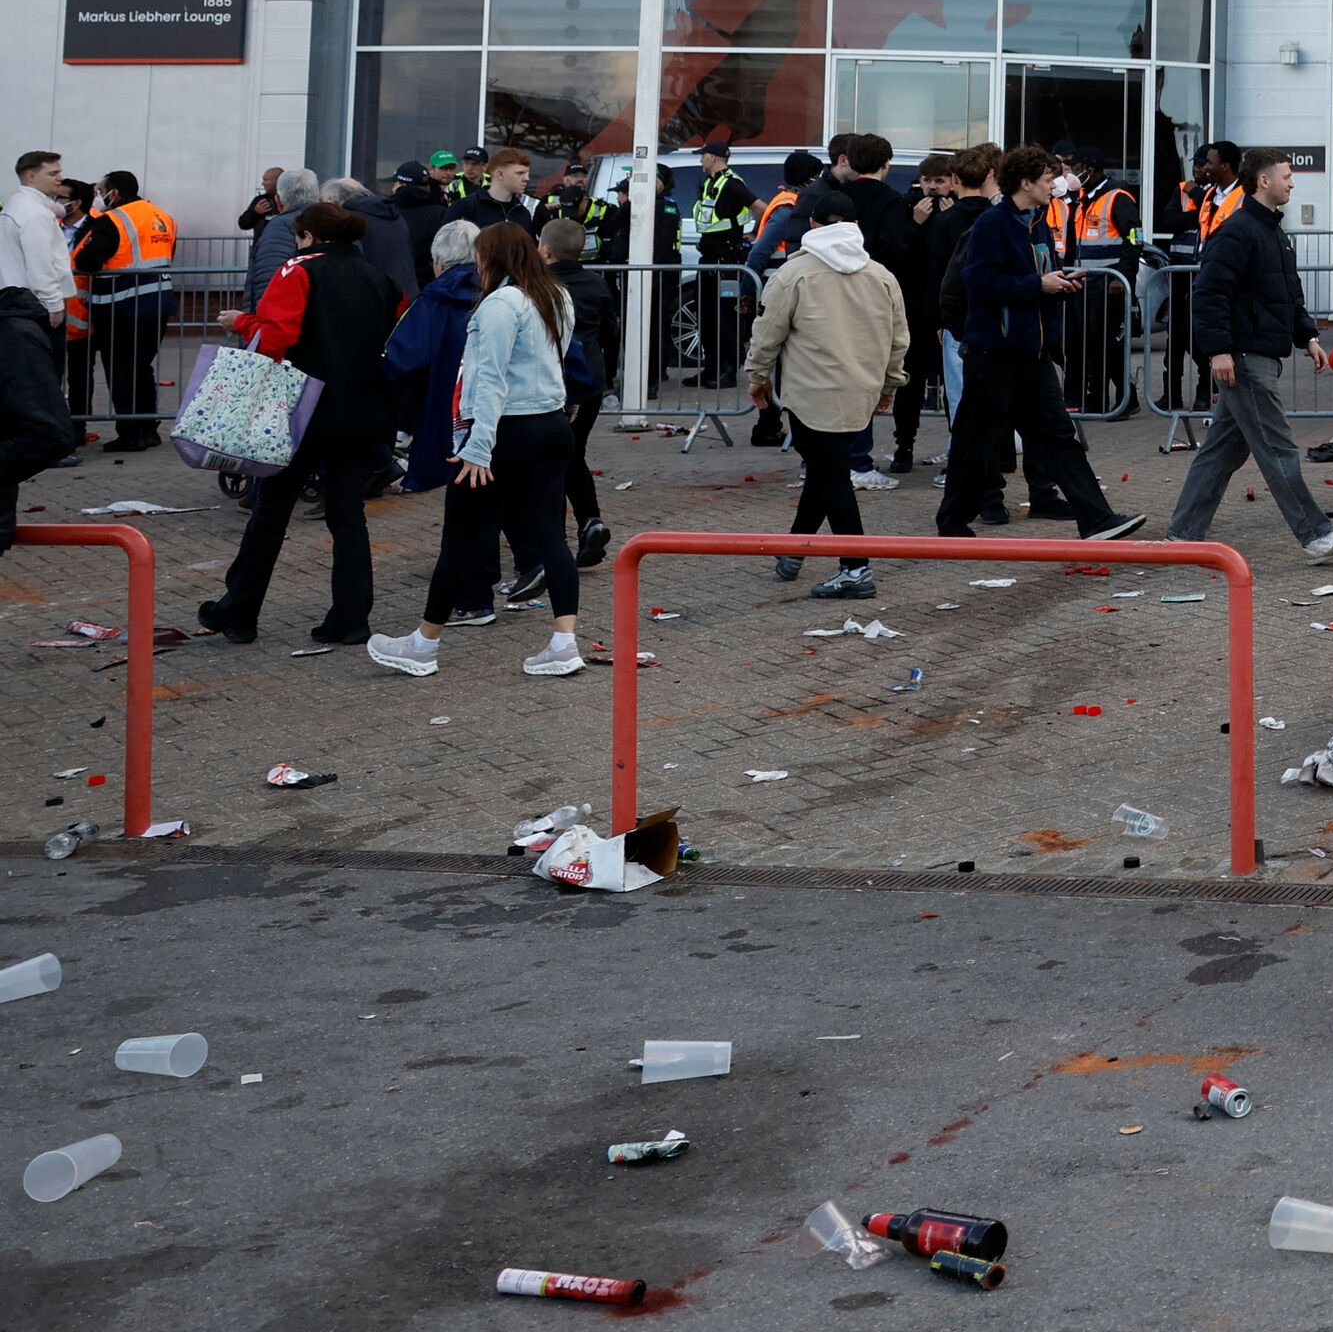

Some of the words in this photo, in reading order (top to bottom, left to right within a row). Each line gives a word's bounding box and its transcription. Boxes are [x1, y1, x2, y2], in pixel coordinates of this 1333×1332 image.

[79, 11, 125, 22] Markus
[129, 11, 180, 22] Liebherr
[184, 11, 231, 25] Lounge
